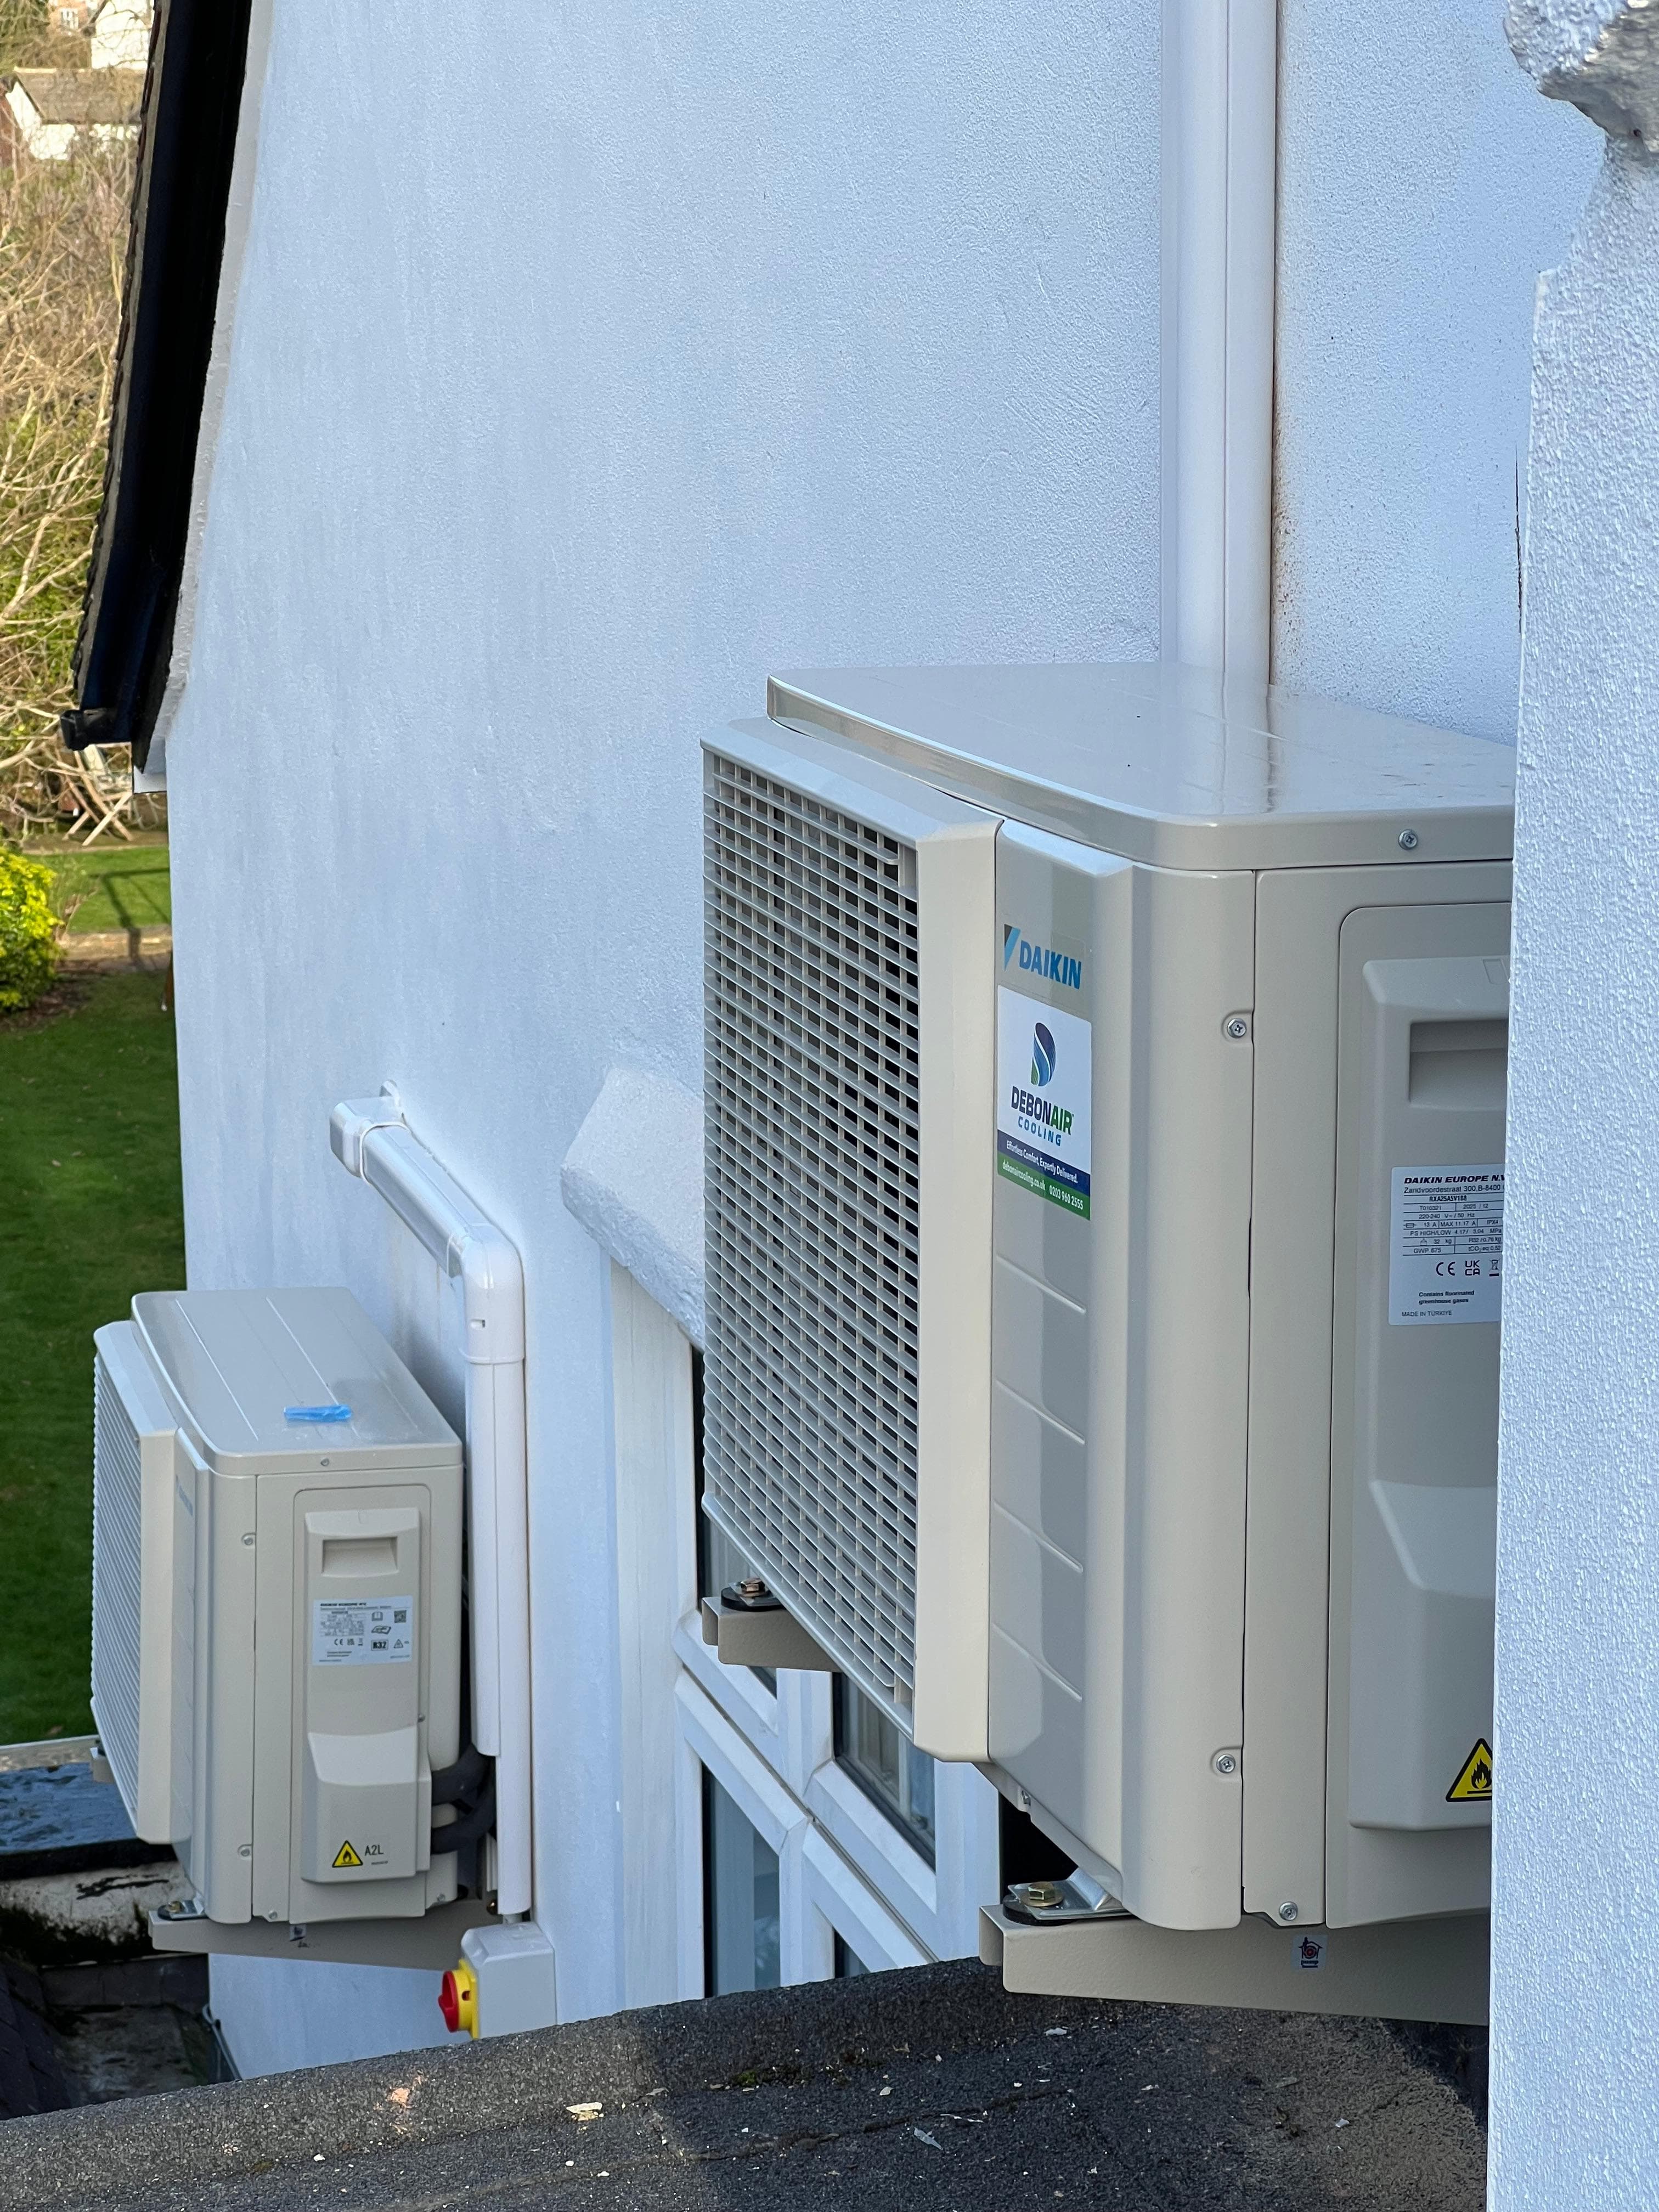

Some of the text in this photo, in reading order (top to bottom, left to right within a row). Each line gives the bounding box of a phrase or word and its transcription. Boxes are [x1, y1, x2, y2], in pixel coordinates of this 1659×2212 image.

[1019, 940, 1082, 990] DAIKIN
[1011, 1086, 1073, 1135] DEBONAIR
[1018, 1116, 1062, 1147] COOLING
[1040, 1158, 1056, 1175] Expertly
[1057, 1165, 1078, 1184] Delivered.
[1049, 1184, 1062, 1199] 0203
[1062, 1191, 1070, 1204] 960
[1071, 1195, 1084, 1210] 2555
[1436, 1261, 1456, 1276] CE
[364, 1844, 384, 1856] A2L
